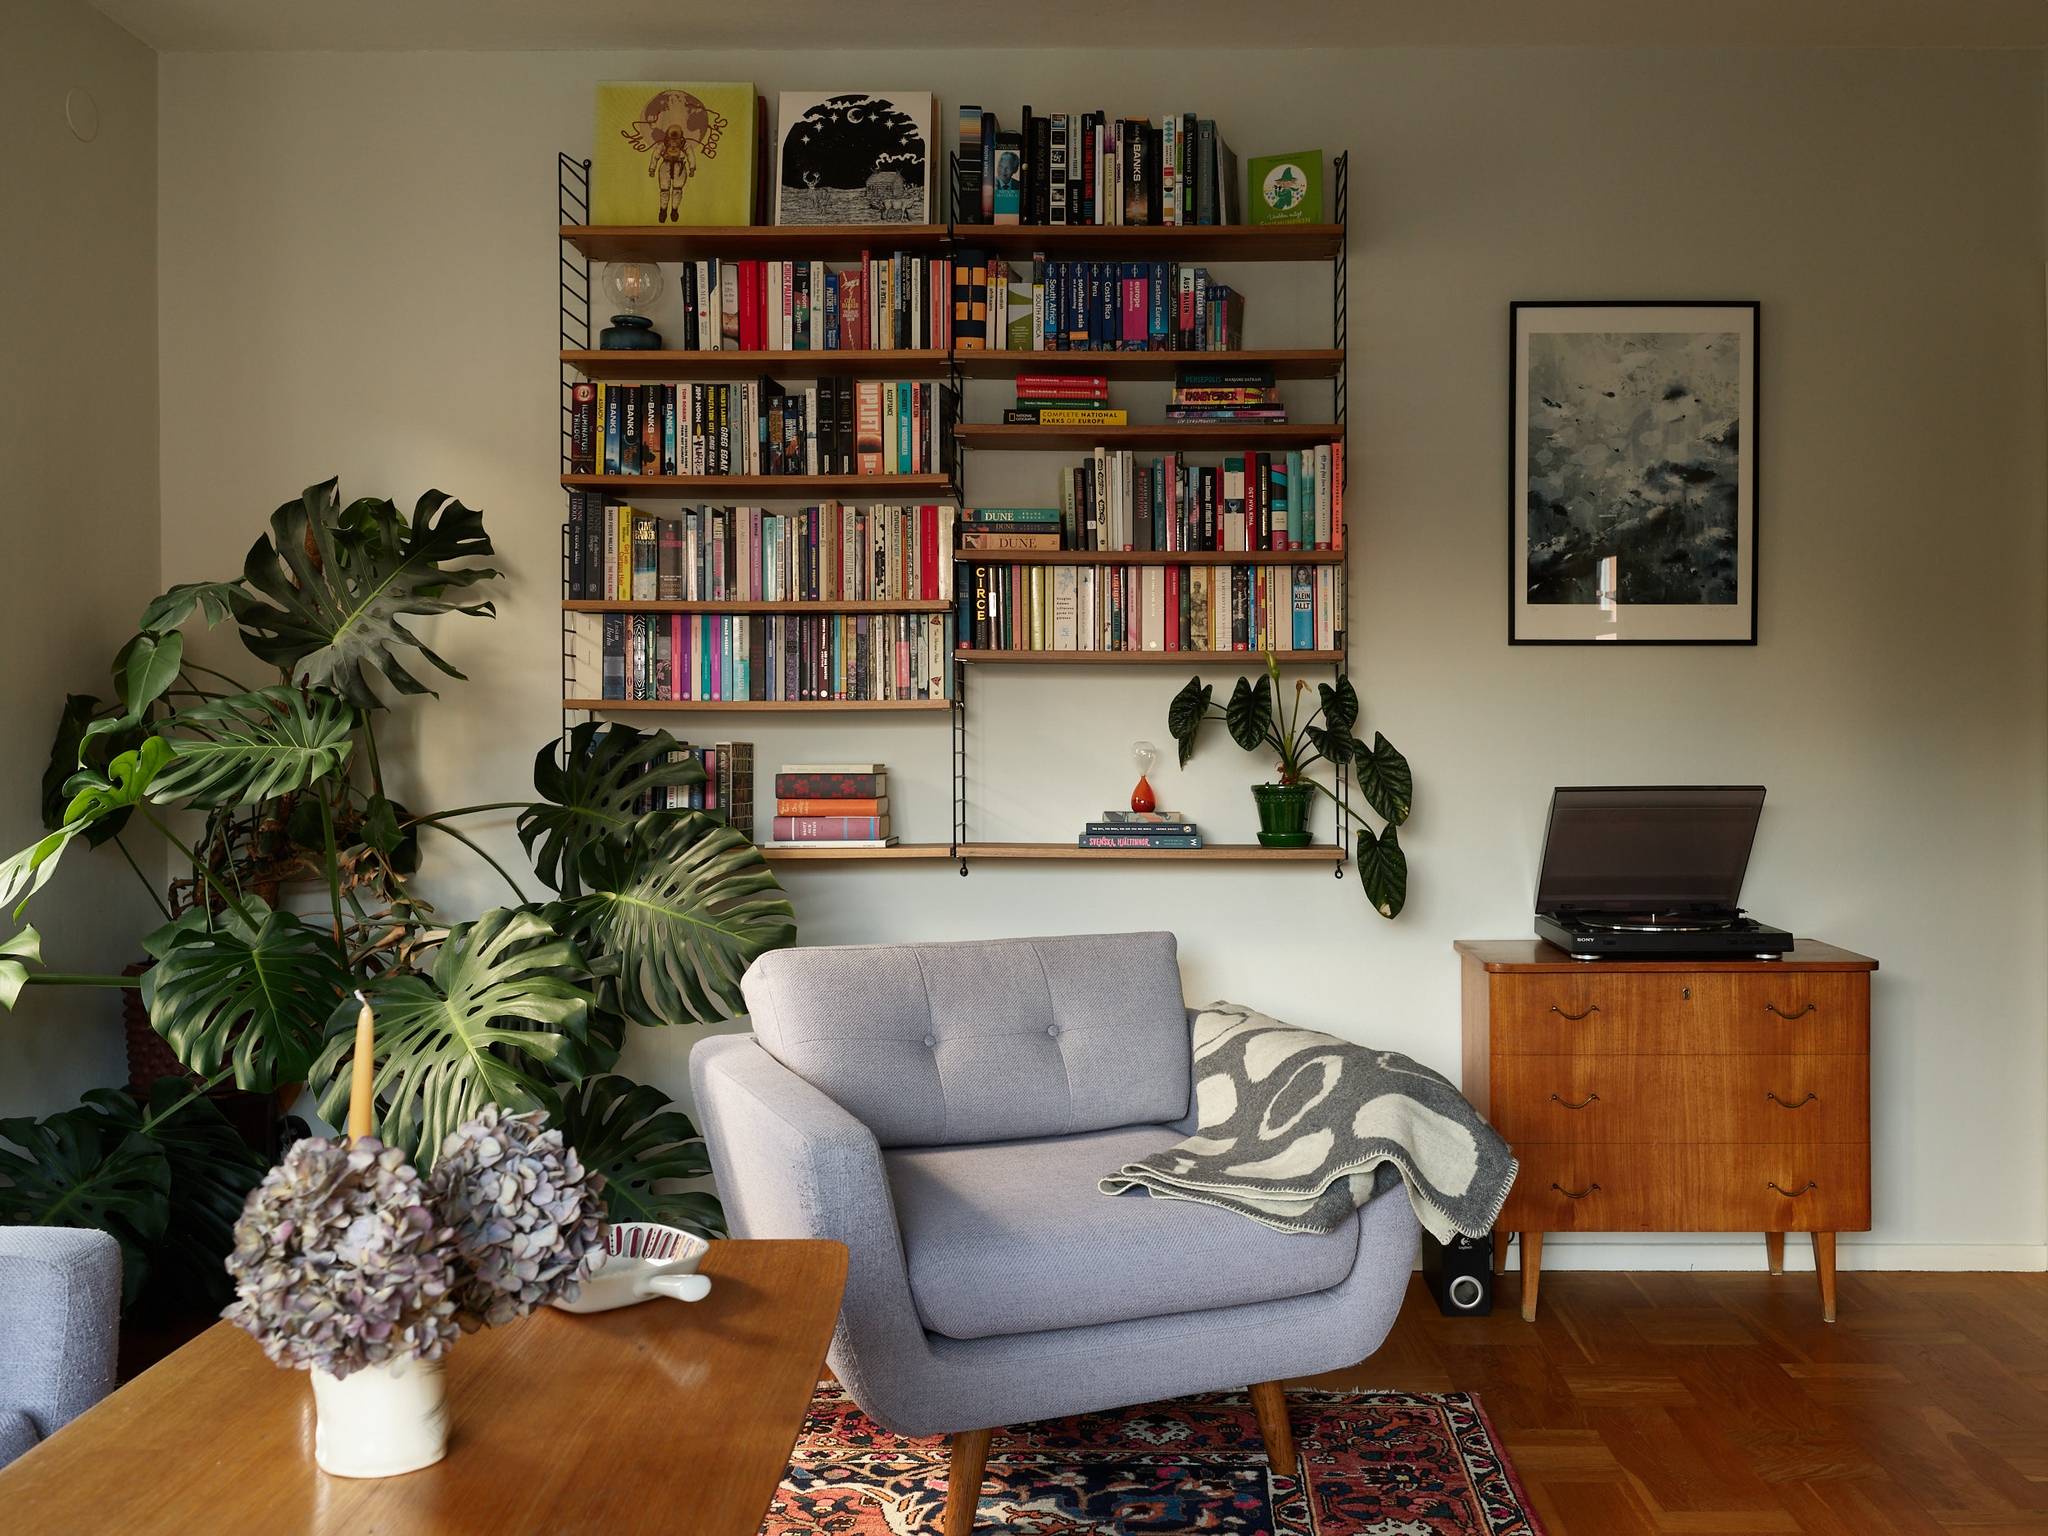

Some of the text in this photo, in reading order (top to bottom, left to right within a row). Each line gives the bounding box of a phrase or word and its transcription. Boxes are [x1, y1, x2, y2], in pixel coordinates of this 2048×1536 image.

[621, 129, 647, 152] The
[1132, 144, 1141, 182] BANKS
[784, 264, 792, 283] CHUCK
[826, 288, 834, 312] PRATCHETT
[1092, 281, 1100, 297] Peru
[1134, 282, 1142, 308] europe
[1196, 278, 1206, 317] NYA ZEELAND
[1104, 282, 1112, 320] Costa Rica
[1155, 280, 1163, 330] Eastern Europe
[861, 384, 879, 431] UPLIFT
[720, 426, 728, 447] GREG
[720, 449, 728, 471] EGAN
[985, 513, 1014, 521] DUNE
[999, 538, 1036, 548] DUNE
[976, 568, 986, 620] CIRCE
[1295, 602, 1310, 610] ALLT
[606, 626, 614, 646] Berlin
[614, 620, 622, 641] Ensam
